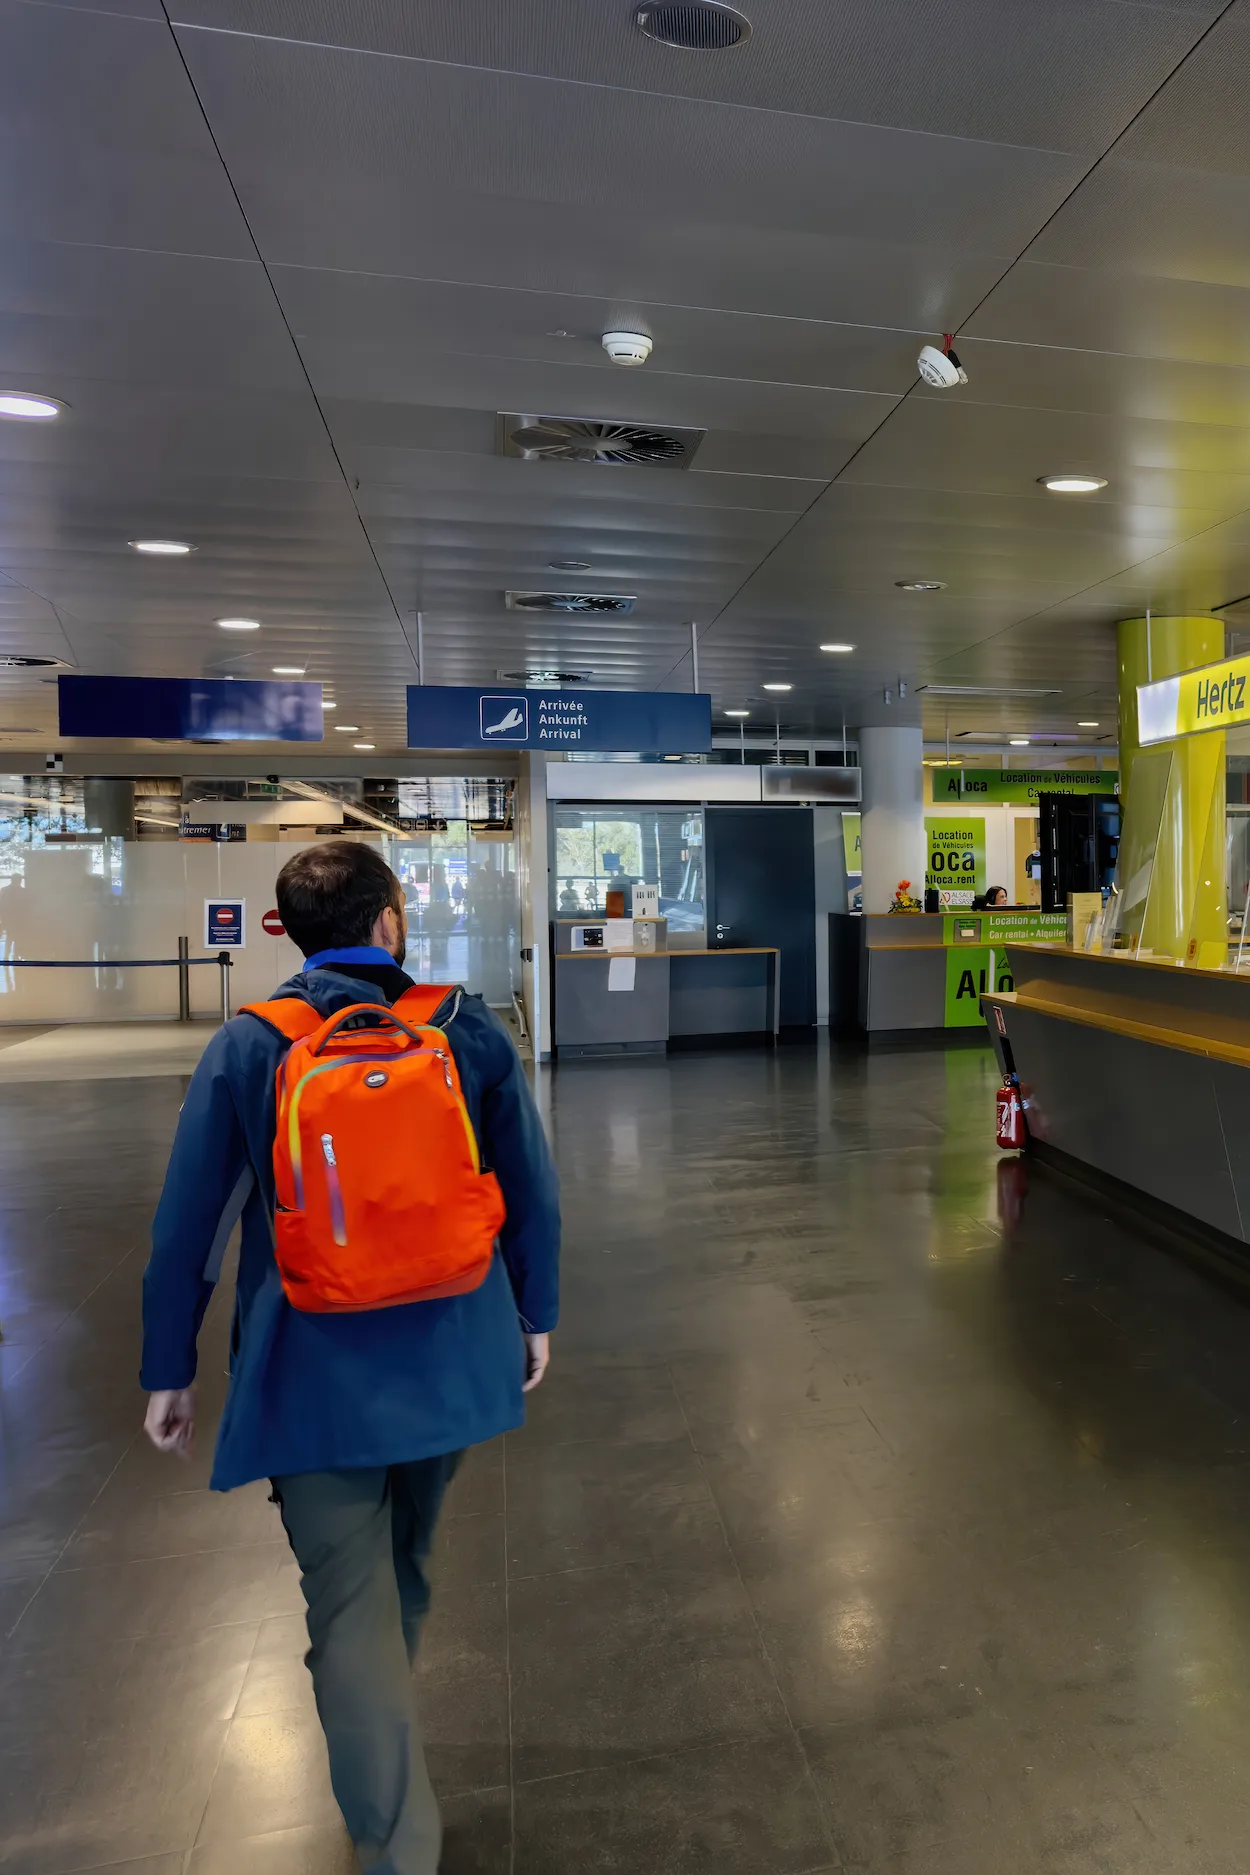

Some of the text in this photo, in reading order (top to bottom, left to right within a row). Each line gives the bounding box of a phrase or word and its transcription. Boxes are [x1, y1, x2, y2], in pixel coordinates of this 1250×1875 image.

[1196, 671, 1247, 719] Hertz
[538, 699, 584, 711] Arrivée
[538, 713, 588, 725] Ankunft
[539, 728, 581, 739] Arrival
[1000, 772, 1042, 784] Location
[1054, 772, 1101, 784] Véhicules
[932, 830, 974, 840] Location
[942, 841, 974, 849] Véhicules
[989, 915, 1028, 926] Location
[989, 930, 1003, 939] Car
[1005, 930, 1028, 939] rental
